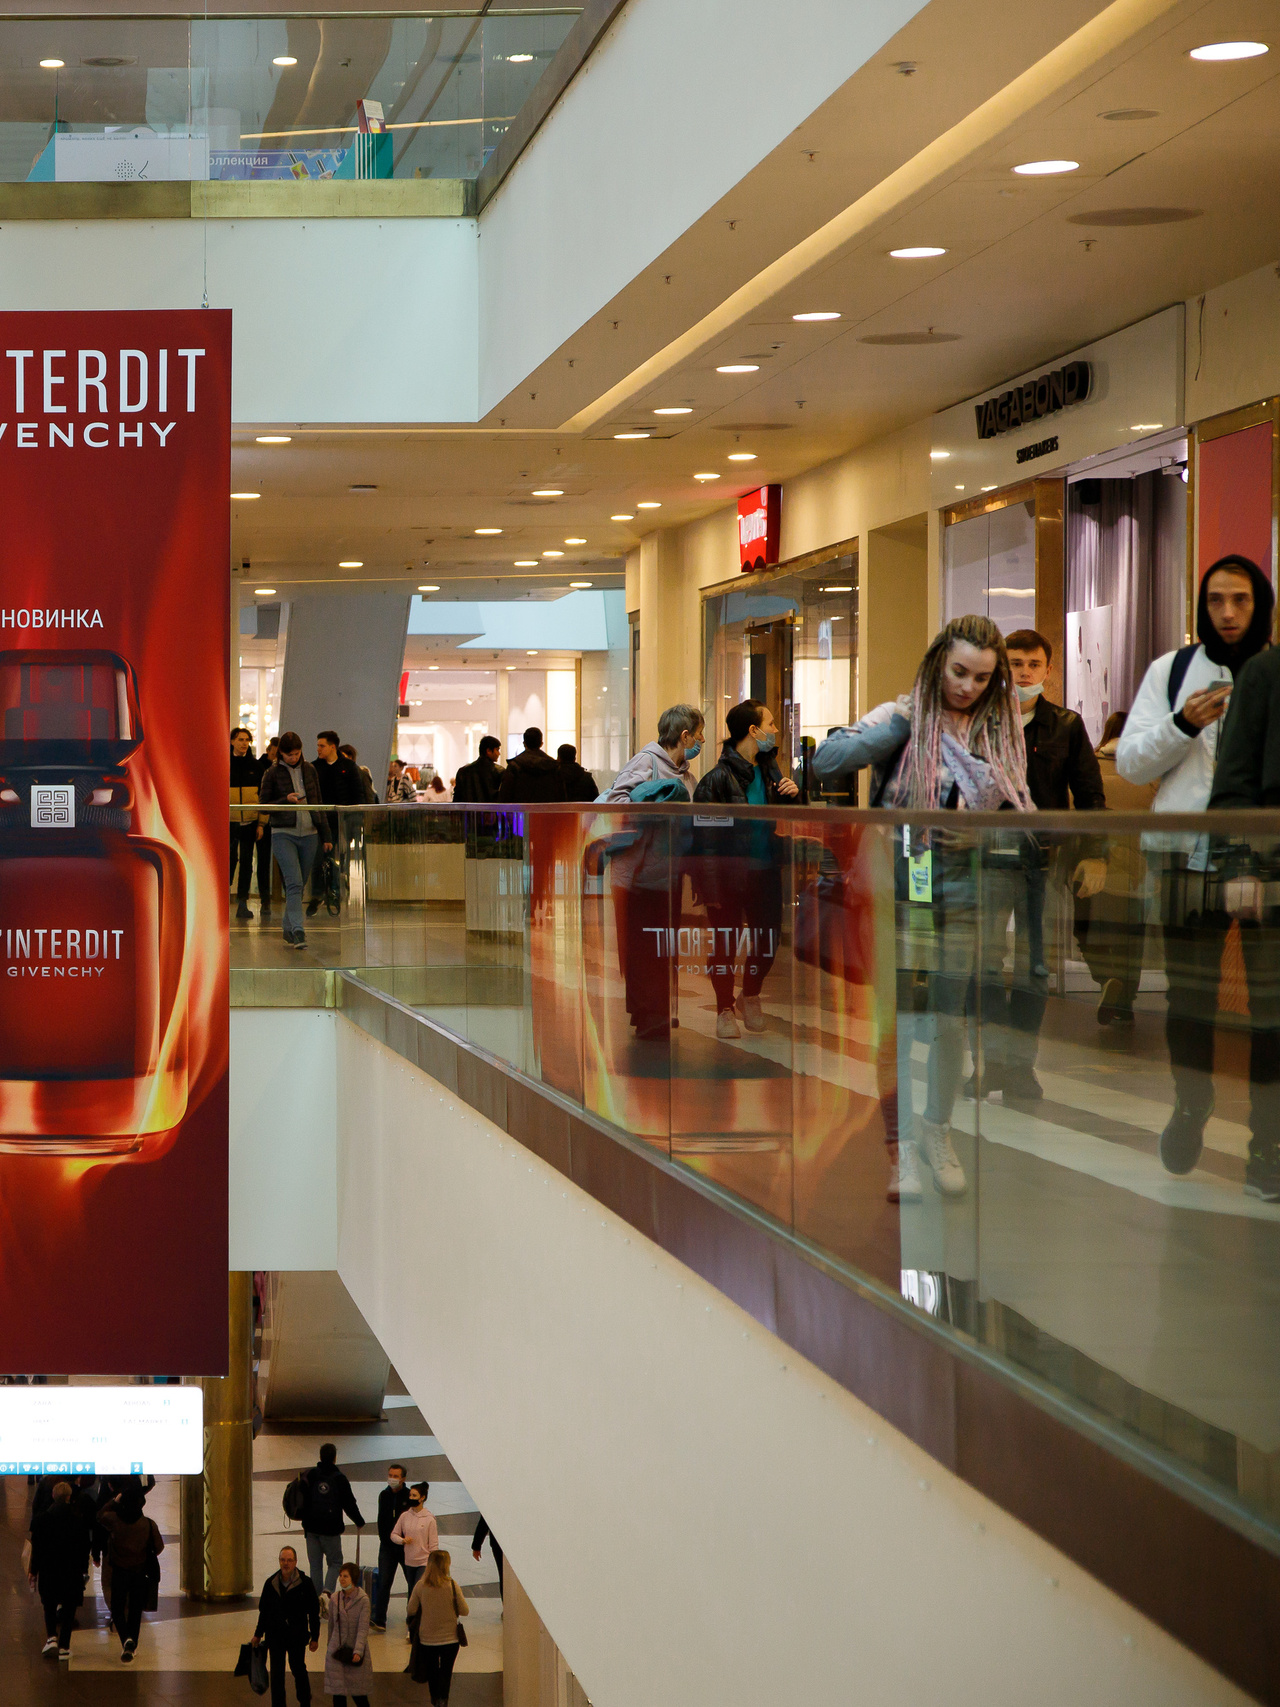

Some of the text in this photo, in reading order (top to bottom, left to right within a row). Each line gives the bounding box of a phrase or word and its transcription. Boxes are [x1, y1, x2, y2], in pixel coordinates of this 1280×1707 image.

[209, 155, 268, 167] оллекция
[975, 361, 1089, 439] VAGABOND
[1, 609, 104, 628] НОВИНКА
[7, 966, 105, 977] GIVENCHY
